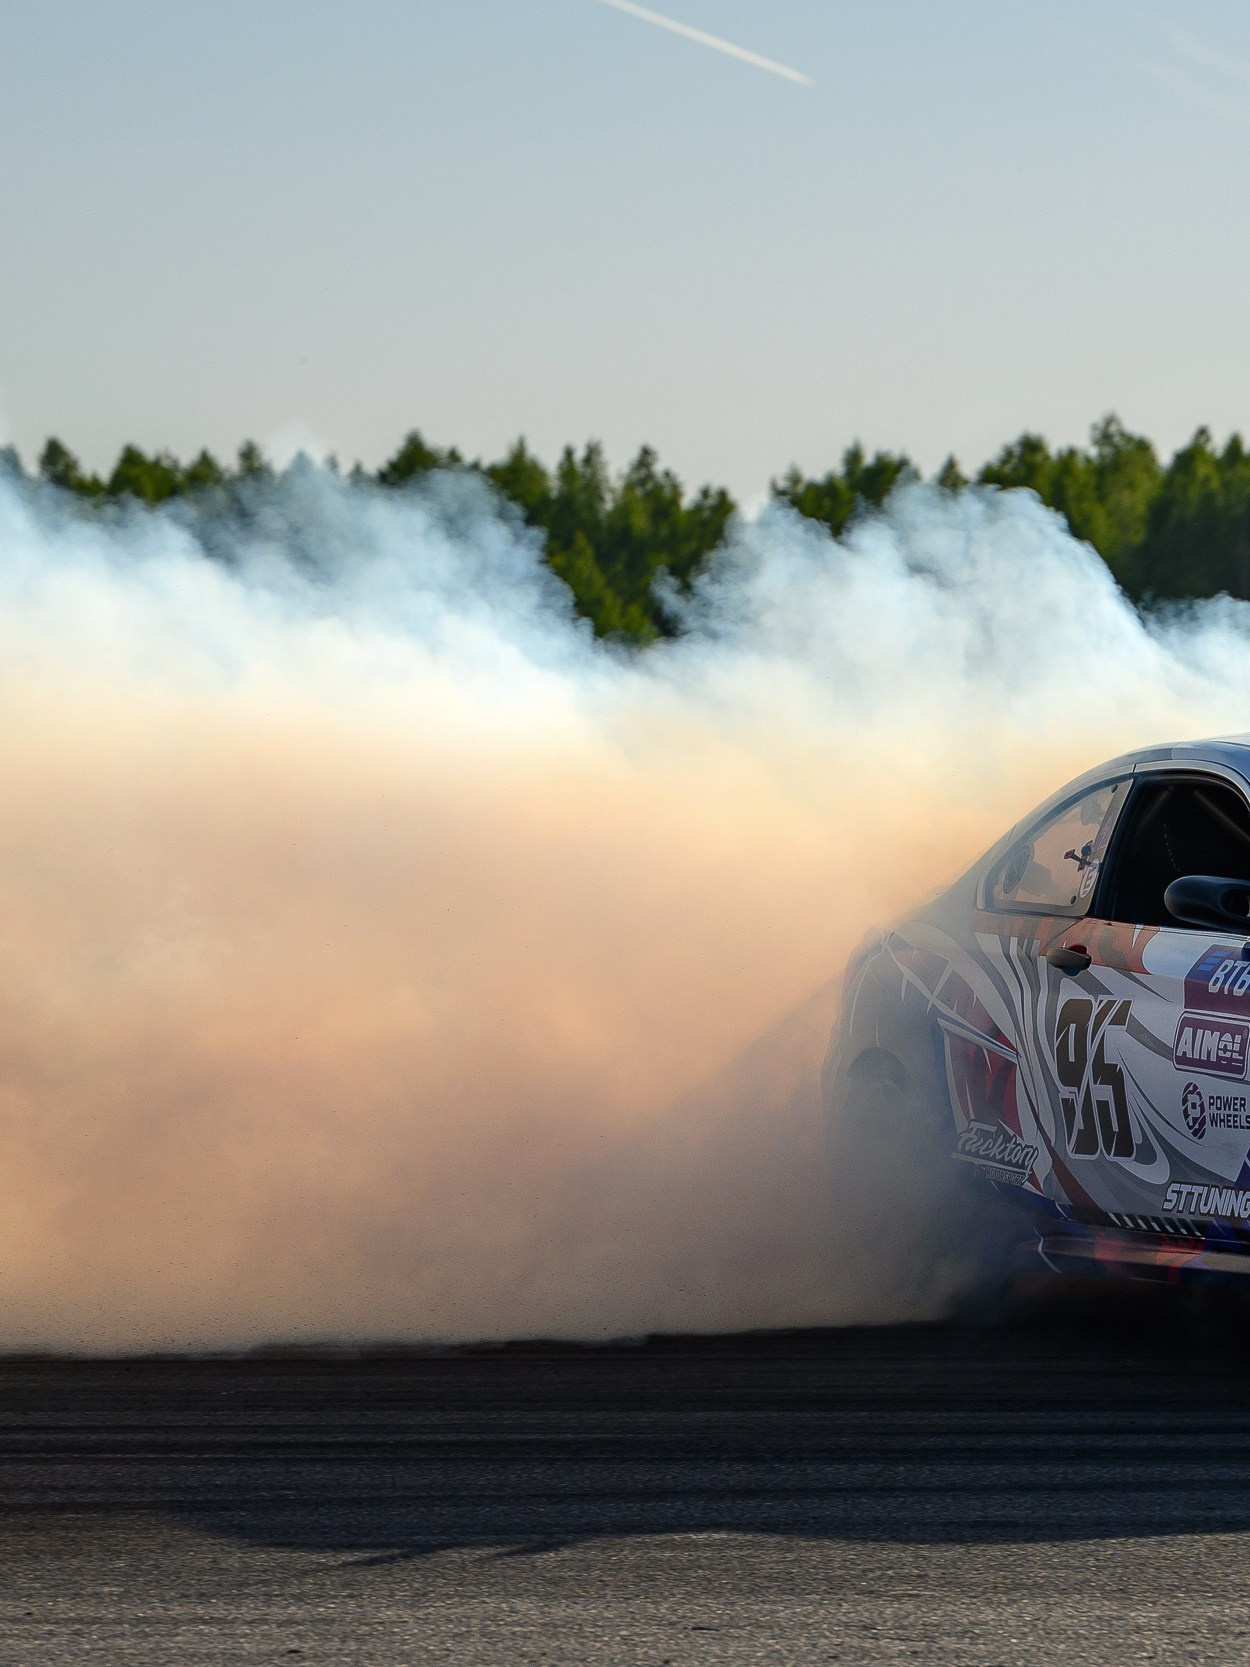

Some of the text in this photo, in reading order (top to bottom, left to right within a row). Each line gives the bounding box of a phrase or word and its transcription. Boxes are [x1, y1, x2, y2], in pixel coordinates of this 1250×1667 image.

[1176, 1026, 1244, 1067] AIMOL
[1055, 997, 1135, 1159] 95
[1208, 1095, 1247, 1112] POWER
